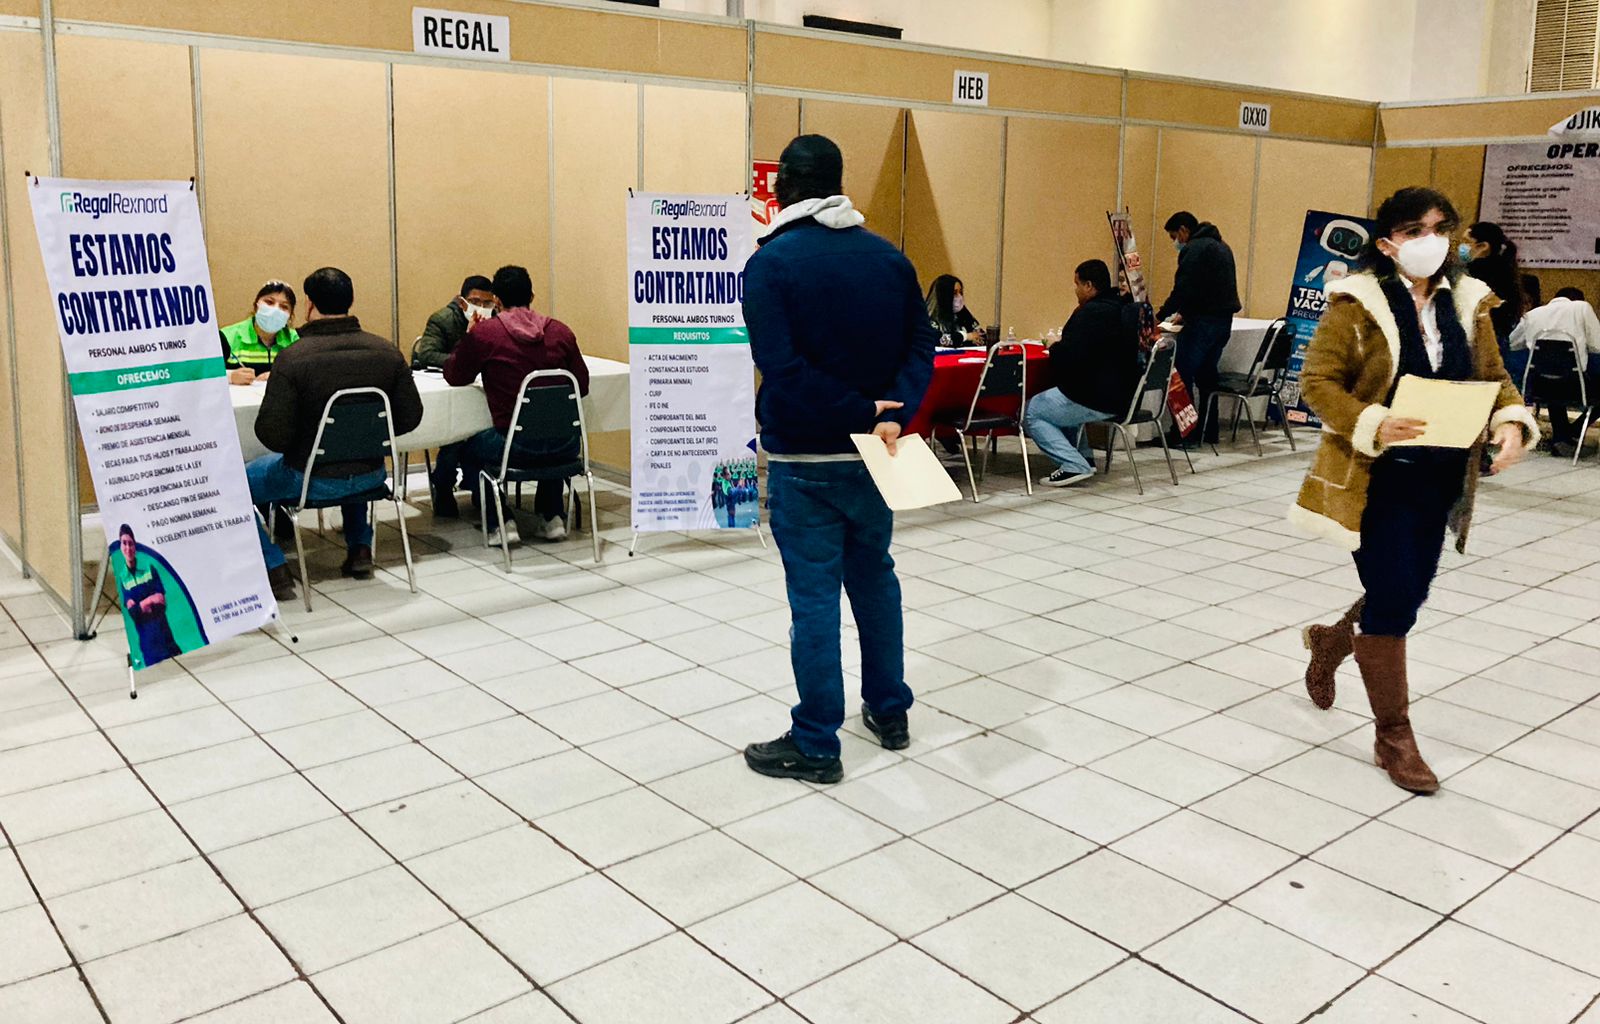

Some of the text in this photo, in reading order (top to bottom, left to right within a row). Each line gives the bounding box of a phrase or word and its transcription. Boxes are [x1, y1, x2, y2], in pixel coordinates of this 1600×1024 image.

[423, 16, 499, 52] REGAL
[958, 76, 984, 100] HEB
[1242, 105, 1267, 127] OXXO
[1546, 143, 1600, 159] OPER
[73, 192, 168, 219] RegalRexnord
[661, 200, 727, 220] RegalRexnord
[652, 226, 727, 260] ESTAMOS
[69, 233, 176, 277] ESTAMOS
[634, 270, 744, 304] CONTRATANDO
[57, 284, 209, 335] CONTRATANDO
[652, 315, 735, 324] PERSONAL AMBOS TURNOS
[673, 331, 711, 341] REQUISITOS
[89, 339, 187, 358] PERSONAL AMBOS TURNOS
[117, 369, 171, 385] OFRECEMOS
[649, 378, 672, 386] (PRIMARIA
[117, 401, 159, 415] COMPETITIVO
[120, 419, 153, 431] DESPENSA
[153, 415, 181, 425] SEMANAL
[121, 439, 128, 449] DE
[129, 435, 166, 447] ASISTENCIA
[167, 429, 191, 440] MENSUAL
[121, 456, 138, 467] PARA
[139, 452, 152, 462] TUS
[174, 441, 218, 456] TRABAJADORES
[681, 449, 718, 457] ANTECEDENTES
[140, 470, 153, 479] POR
[154, 466, 175, 477] ENCIMA
[175, 463, 183, 473] DE
[184, 462, 191, 471] LA
[192, 460, 202, 469] LEY
[149, 485, 160, 495] POR
[160, 481, 183, 493] ENCIMA
[184, 478, 191, 488] DE
[191, 477, 199, 486] LA
[199, 475, 209, 485] LEY
[147, 498, 180, 512] DESCANSO
[189, 494, 197, 502] DE
[197, 489, 220, 501] SEMANA
[151, 517, 169, 528] PAGO
[192, 506, 218, 518] SEMANAL
[156, 514, 250, 545] EXCELENTE AMBIENTE DE TRABAJO
